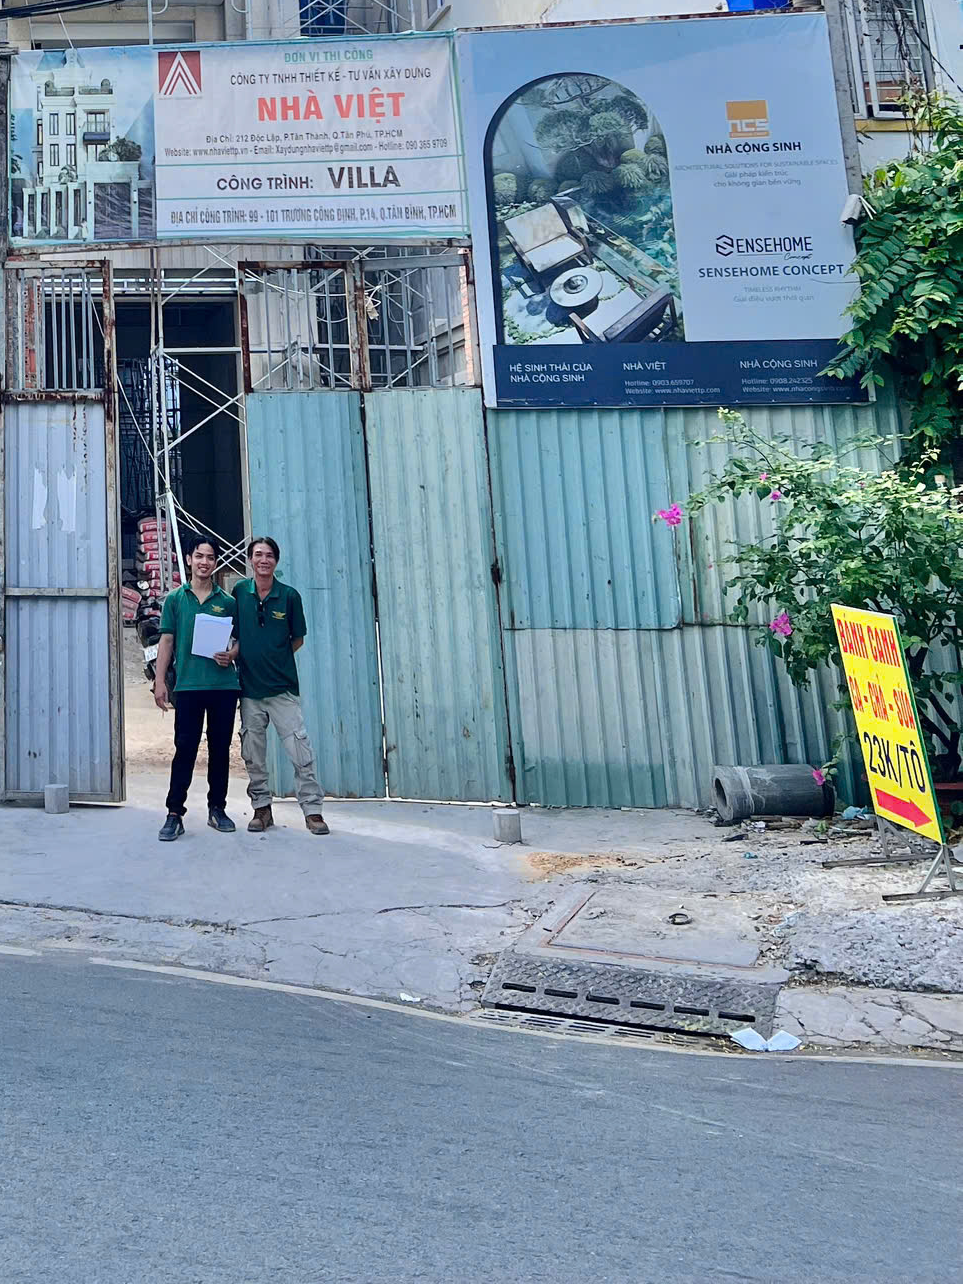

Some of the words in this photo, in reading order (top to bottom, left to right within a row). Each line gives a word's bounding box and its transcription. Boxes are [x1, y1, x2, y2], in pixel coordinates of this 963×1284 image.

[323, 50, 341, 61] THI
[344, 47, 373, 60] CÔNG
[230, 71, 256, 85] CÔNG
[258, 73, 270, 84] TY
[272, 72, 297, 84] TNHH
[299, 69, 326, 83] THIẾT
[328, 67, 341, 82] KẾ
[348, 69, 360, 81] TƯ
[363, 66, 379, 80] VẤN
[383, 66, 403, 80] XÂY
[257, 89, 324, 122] NHÀ
[333, 87, 406, 124] VIỆT
[206, 135, 218, 144] Địa
[236, 134, 249, 143] 212
[374, 129, 404, 137] TP.HCM
[164, 147, 192, 157] Website:
[254, 145, 274, 155] Email:
[378, 141, 405, 151] Hotline:
[405, 140, 418, 150] 090
[706, 142, 733, 155] NHÀ
[735, 141, 770, 156] CỘNG
[772, 141, 802, 152] SINH
[216, 174, 262, 191] CÔNG
[266, 173, 314, 190] TRÌNH:
[327, 165, 401, 189] VILLA
[713, 180, 727, 188] cho
[170, 210, 184, 227] ĐỊA
[185, 206, 198, 224] CHỈ
[199, 207, 220, 224] CÔNG
[222, 207, 247, 224] TRÌNH:
[248, 209, 258, 222] 99
[266, 209, 279, 223] 101
[313, 205, 335, 222] CÔNG
[380, 204, 403, 221] Q.TÂN
[428, 204, 457, 220] TP.HCM
[698, 265, 780, 278] SENSEHOME
[782, 264, 844, 276] CONCEPT
[524, 363, 547, 373] SINH
[548, 362, 571, 372] THÁI
[572, 361, 593, 372] CỦA
[622, 360, 644, 371] NHÀ
[739, 358, 761, 369] NHÀ
[762, 358, 792, 370] CỘNG
[794, 359, 818, 369] SINH
[510, 373, 531, 383] NHÀ
[531, 372, 560, 384] CỘNG
[562, 373, 585, 383] SINH
[625, 387, 654, 395] Website:
[836, 612, 869, 660] BÁNH
[866, 625, 901, 668] CANH
[863, 730, 926, 794] 23K/TÔ
